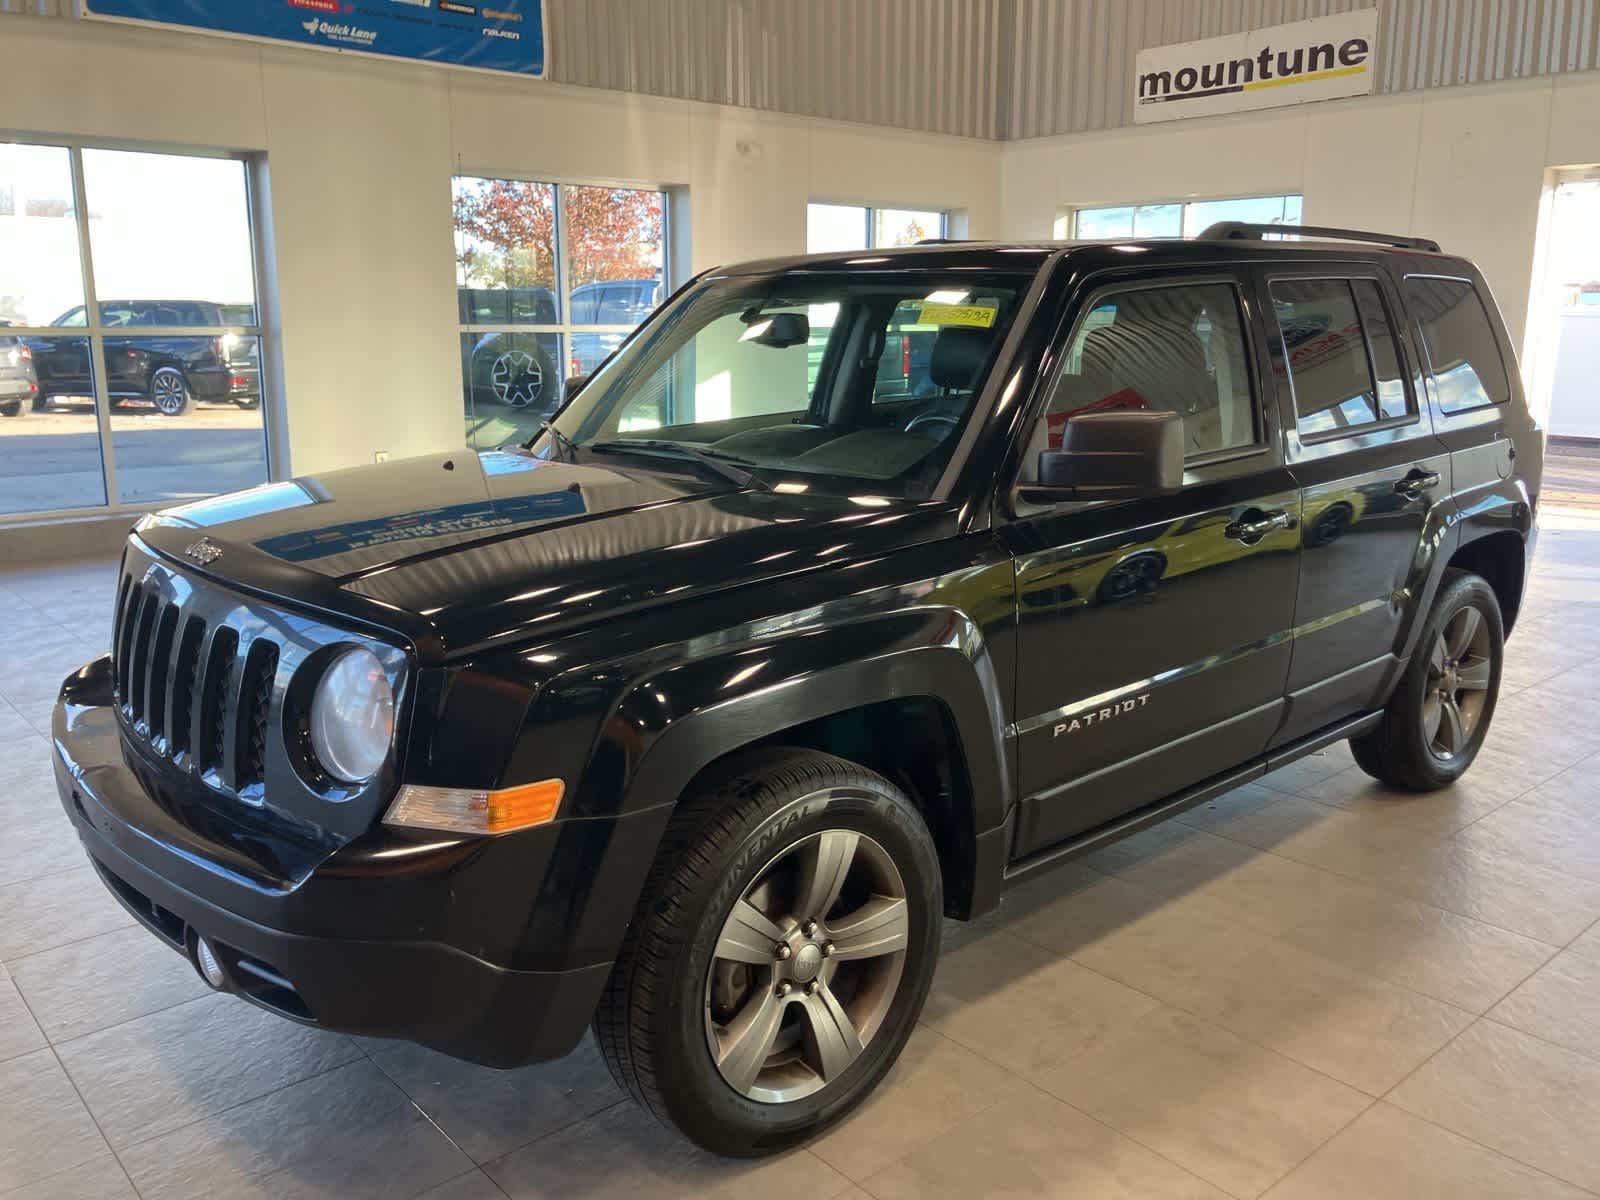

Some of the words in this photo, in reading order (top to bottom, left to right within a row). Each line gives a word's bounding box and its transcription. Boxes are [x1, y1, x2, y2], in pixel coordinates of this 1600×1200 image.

[319, 22, 350, 36] Quick
[350, 26, 377, 40] Lane
[1139, 38, 1369, 98] mountune
[1053, 694, 1151, 737] PATRIOT
